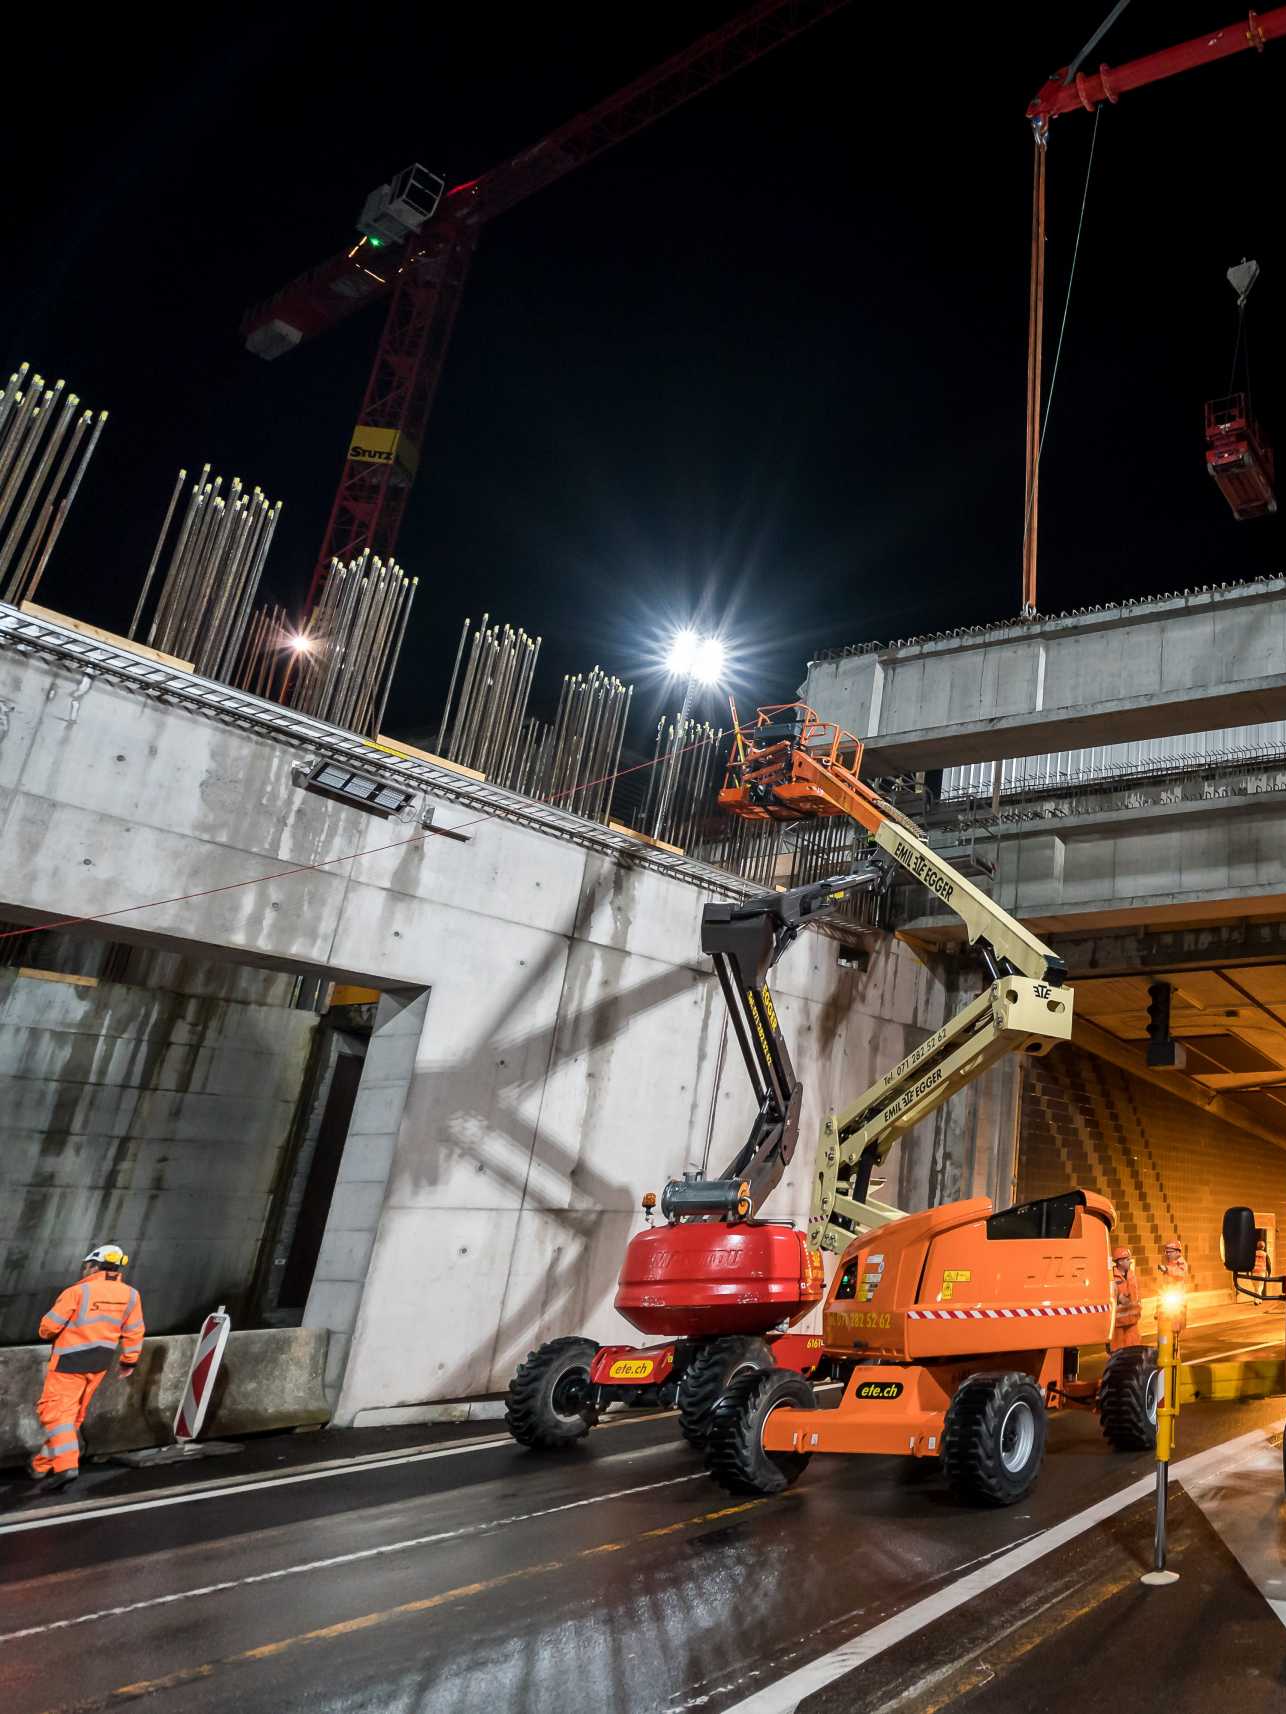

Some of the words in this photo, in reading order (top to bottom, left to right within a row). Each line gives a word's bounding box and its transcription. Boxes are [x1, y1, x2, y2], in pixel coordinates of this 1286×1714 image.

[351, 446, 393, 460] STUTZ
[894, 842, 913, 868] EMIL
[923, 867, 954, 902] EGGER
[897, 1060, 909, 1076] 071
[911, 1047, 925, 1064] 282
[926, 1039, 936, 1052] 52
[937, 1028, 946, 1042] 62
[884, 1102, 902, 1122] EMIL
[915, 1069, 942, 1098] EGGER
[866, 1313, 878, 1328] 52
[879, 1313, 891, 1329] 62
[615, 1363, 648, 1375] ete.ch
[861, 1384, 898, 1397] ete.ch
